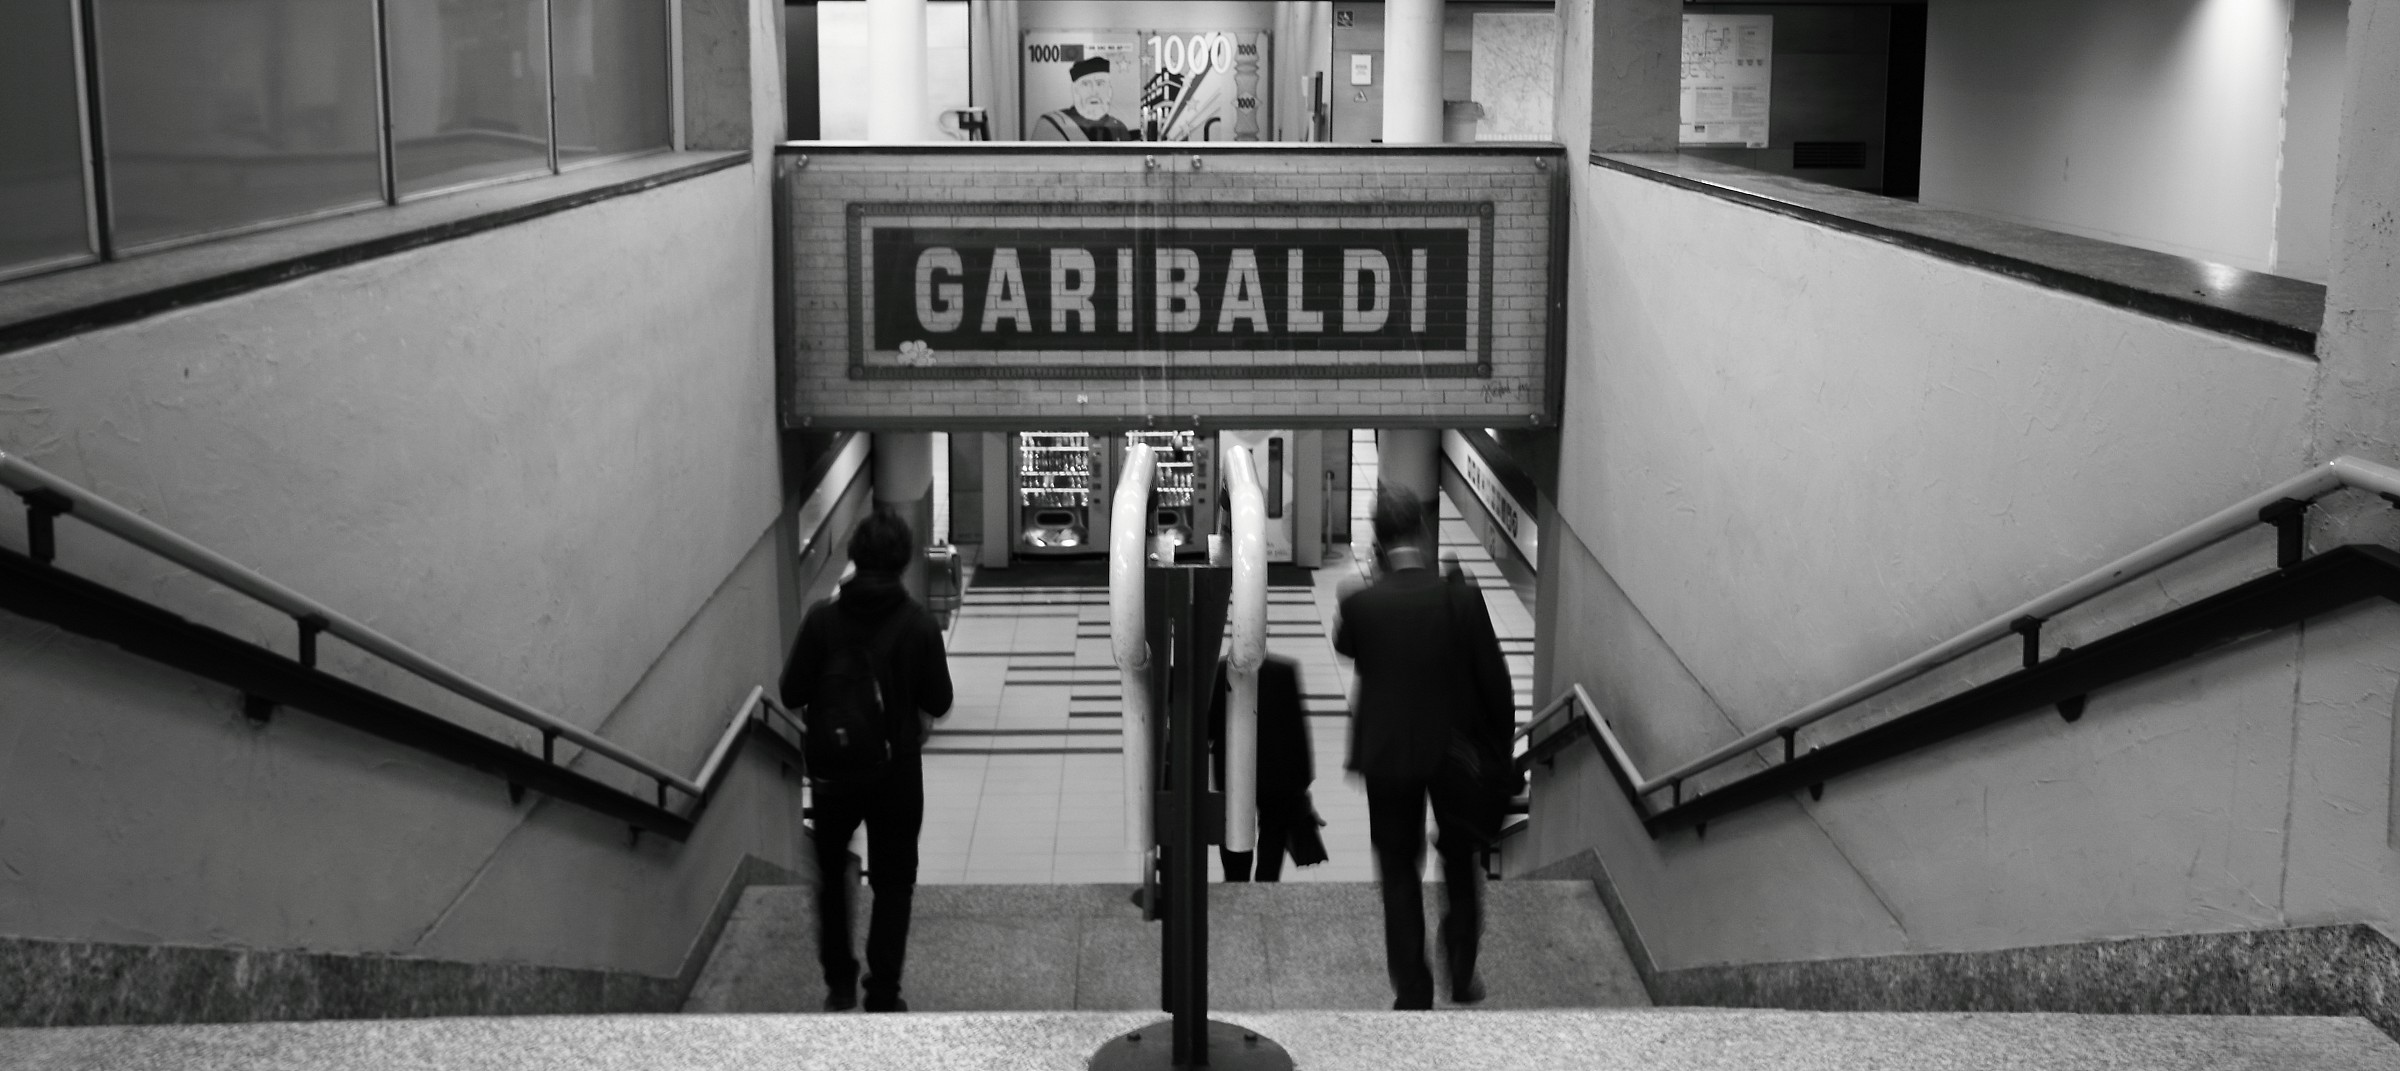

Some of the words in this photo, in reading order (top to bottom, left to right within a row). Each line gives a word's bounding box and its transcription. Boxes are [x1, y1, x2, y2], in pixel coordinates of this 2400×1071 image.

[1028, 44, 1059, 62] 1000
[1148, 35, 1231, 74] 1000
[1238, 44, 1256, 55] 1000
[1237, 98, 1255, 108] 1000
[915, 247, 1427, 333] GARIBALDI
